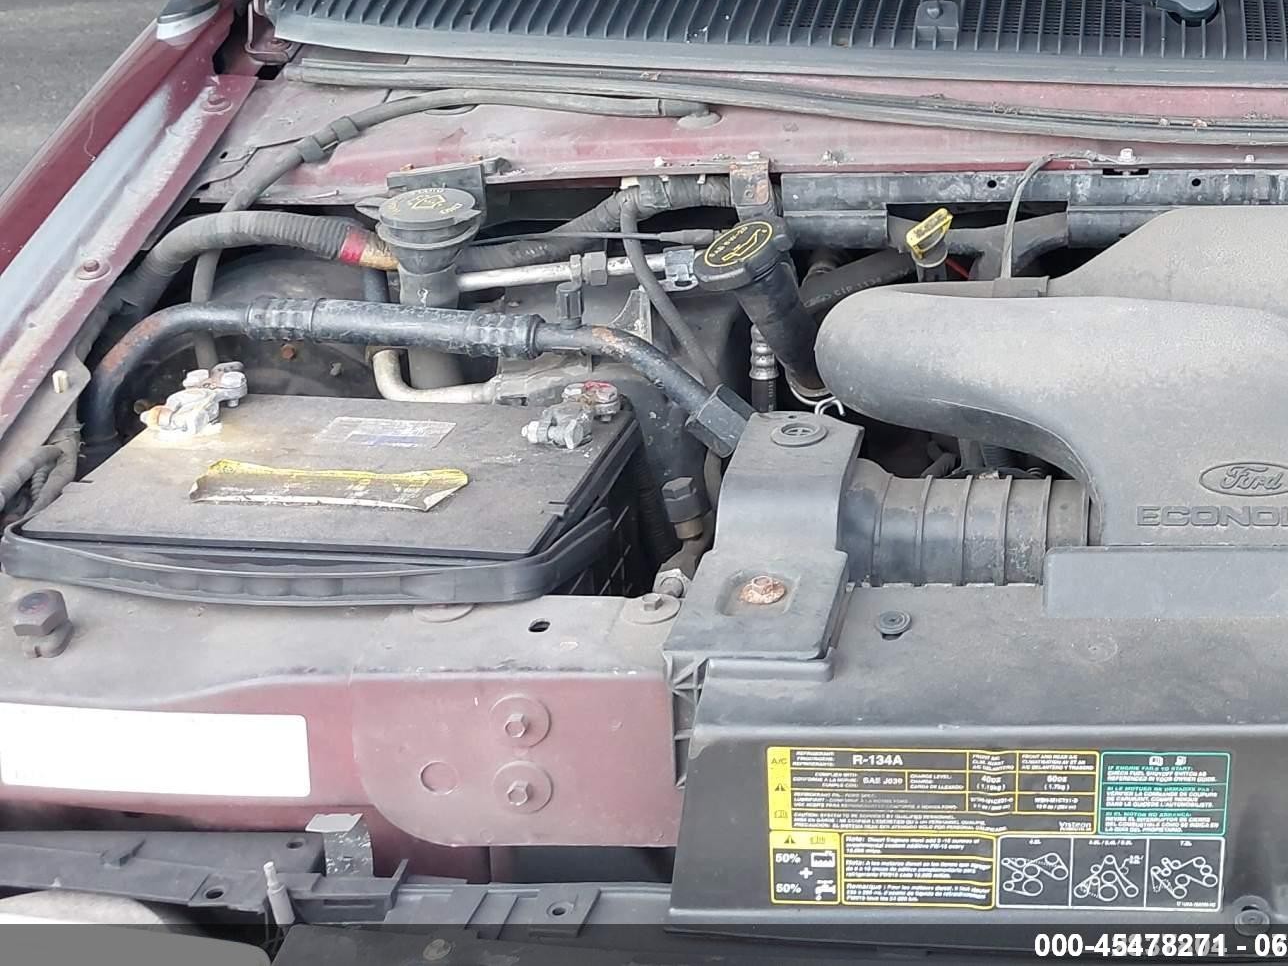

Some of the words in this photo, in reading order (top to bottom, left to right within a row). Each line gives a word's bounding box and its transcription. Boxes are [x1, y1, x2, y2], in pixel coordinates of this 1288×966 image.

[1220, 466, 1284, 490] Ford
[852, 754, 903, 765] R-134A
[775, 853, 801, 863] 50%
[776, 883, 802, 893] 50%
